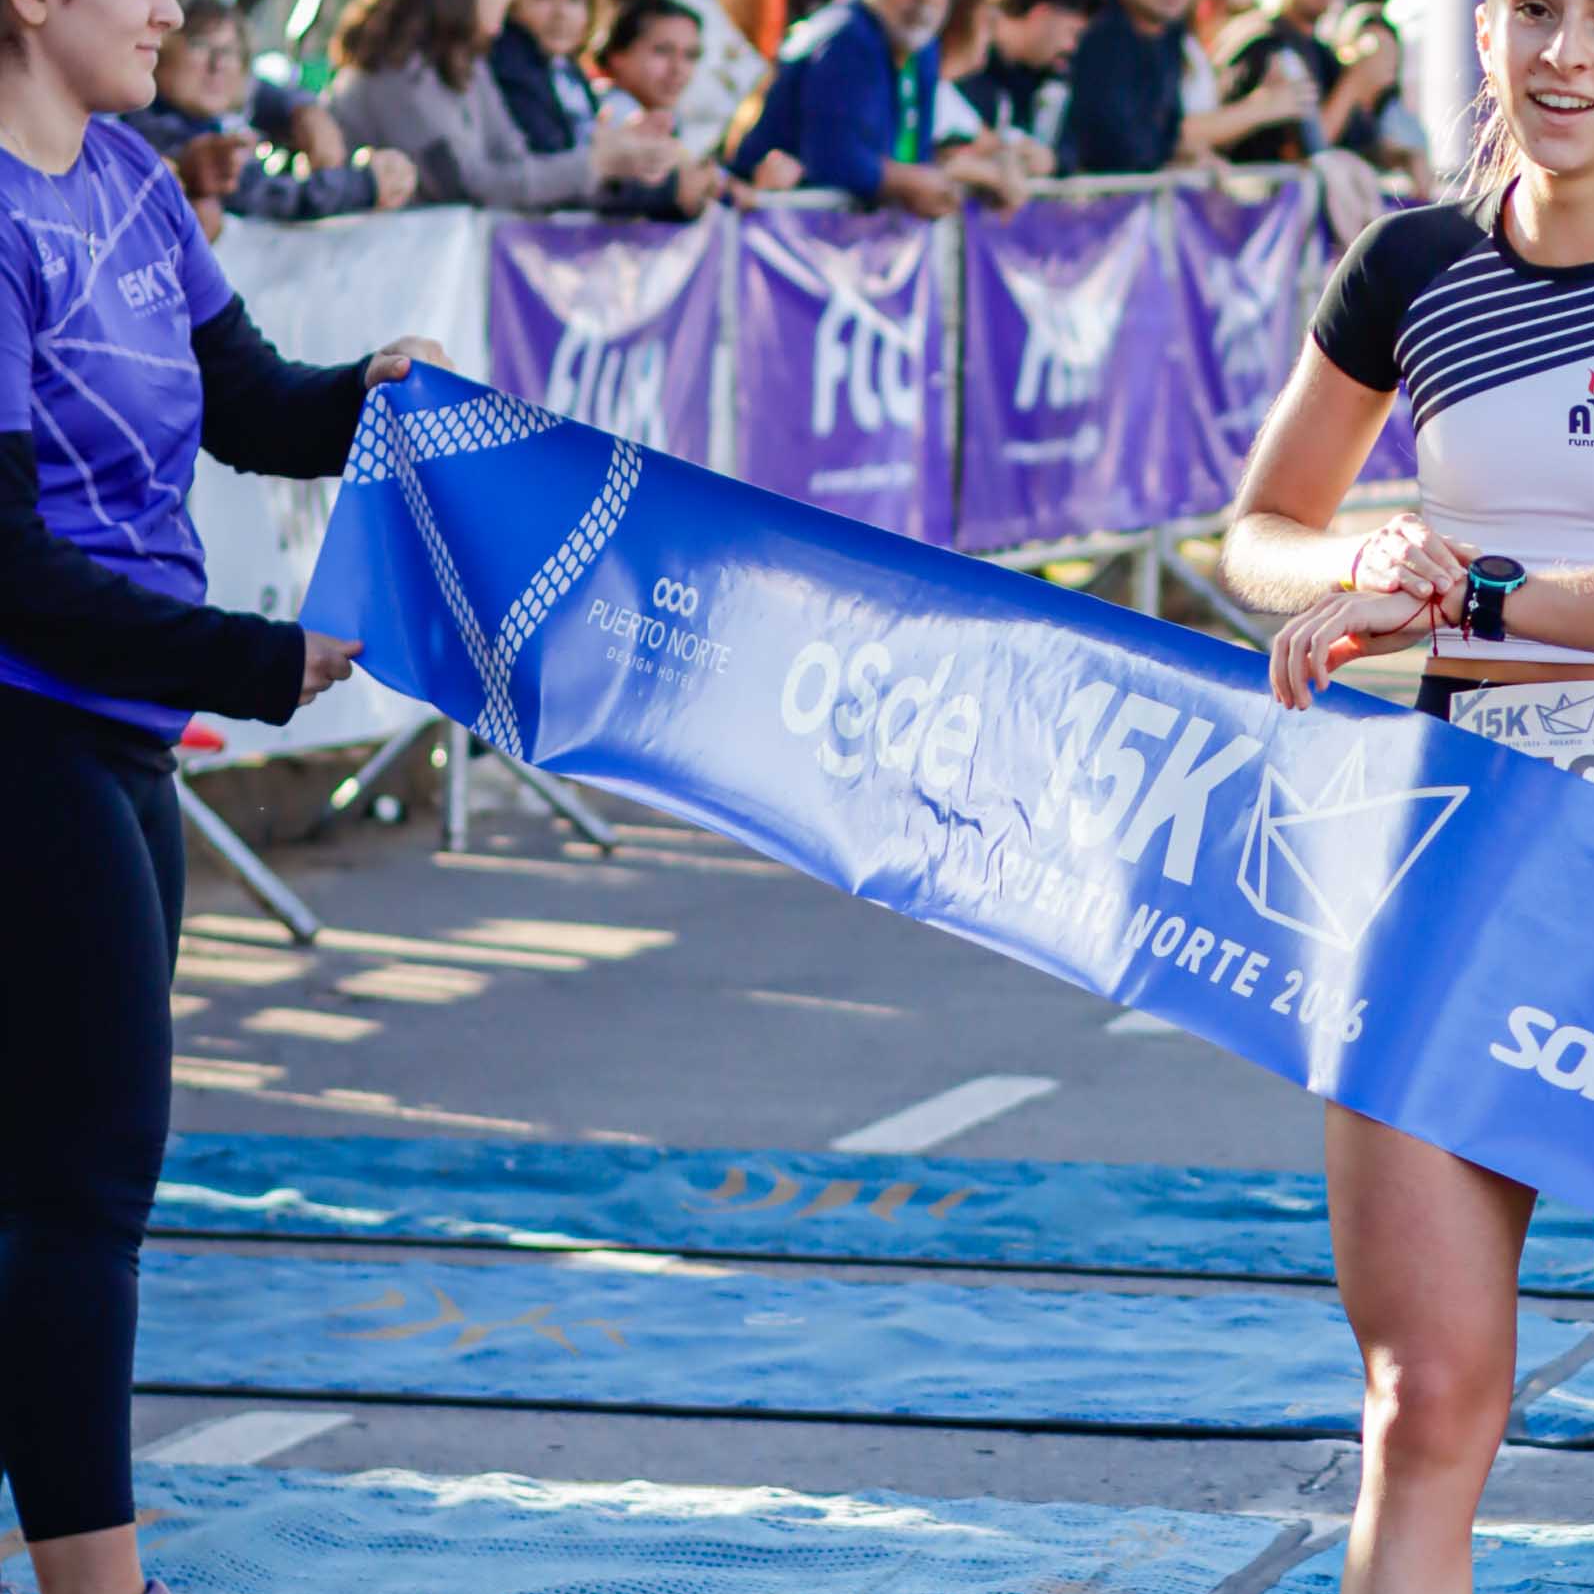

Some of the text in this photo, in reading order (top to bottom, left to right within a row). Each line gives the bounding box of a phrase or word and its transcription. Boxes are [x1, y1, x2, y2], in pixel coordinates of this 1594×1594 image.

[587, 598, 733, 675] PUERTO NORTE
[606, 645, 697, 692] DESIGN HOTEL
[1472, 704, 1530, 738] 15K
[1033, 679, 1264, 887] 15K
[1120, 903, 1271, 999] NORTE
[1269, 968, 1370, 1044] 2026
